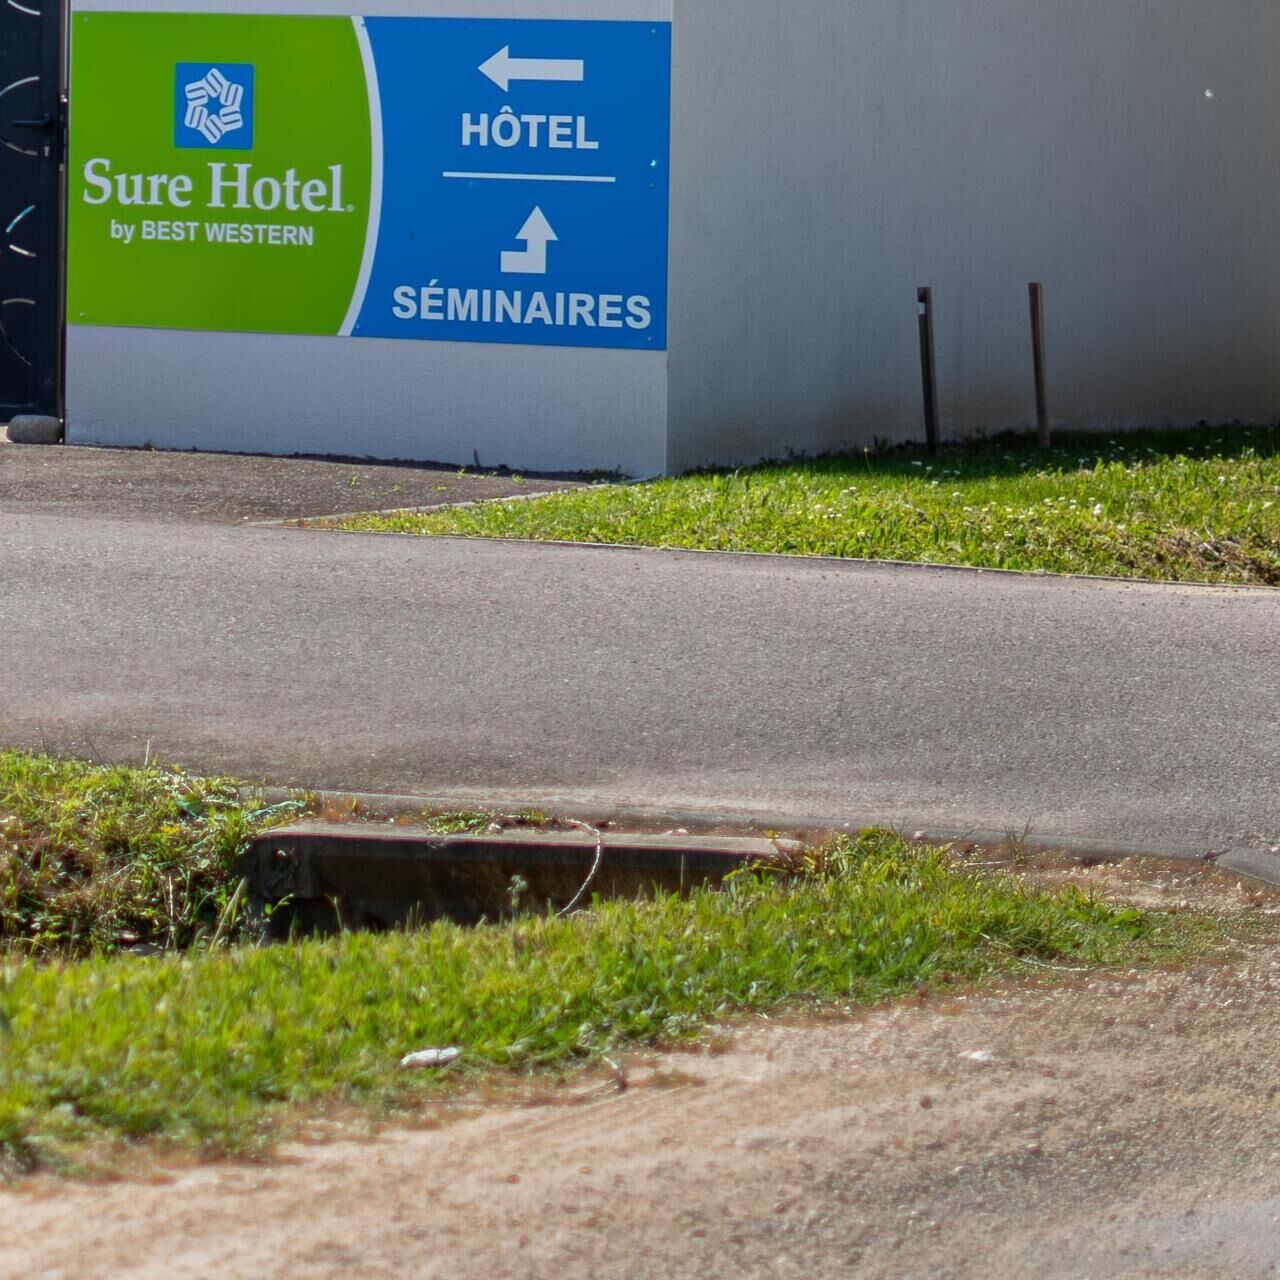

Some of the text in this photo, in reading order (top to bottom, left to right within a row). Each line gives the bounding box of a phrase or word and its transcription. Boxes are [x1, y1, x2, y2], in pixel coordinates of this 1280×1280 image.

[461, 105, 599, 150] HÔTEL
[82, 157, 194, 208] Sure
[110, 218, 314, 247] by BEST WESTERN
[392, 279, 651, 329] SÉMINAIRES
